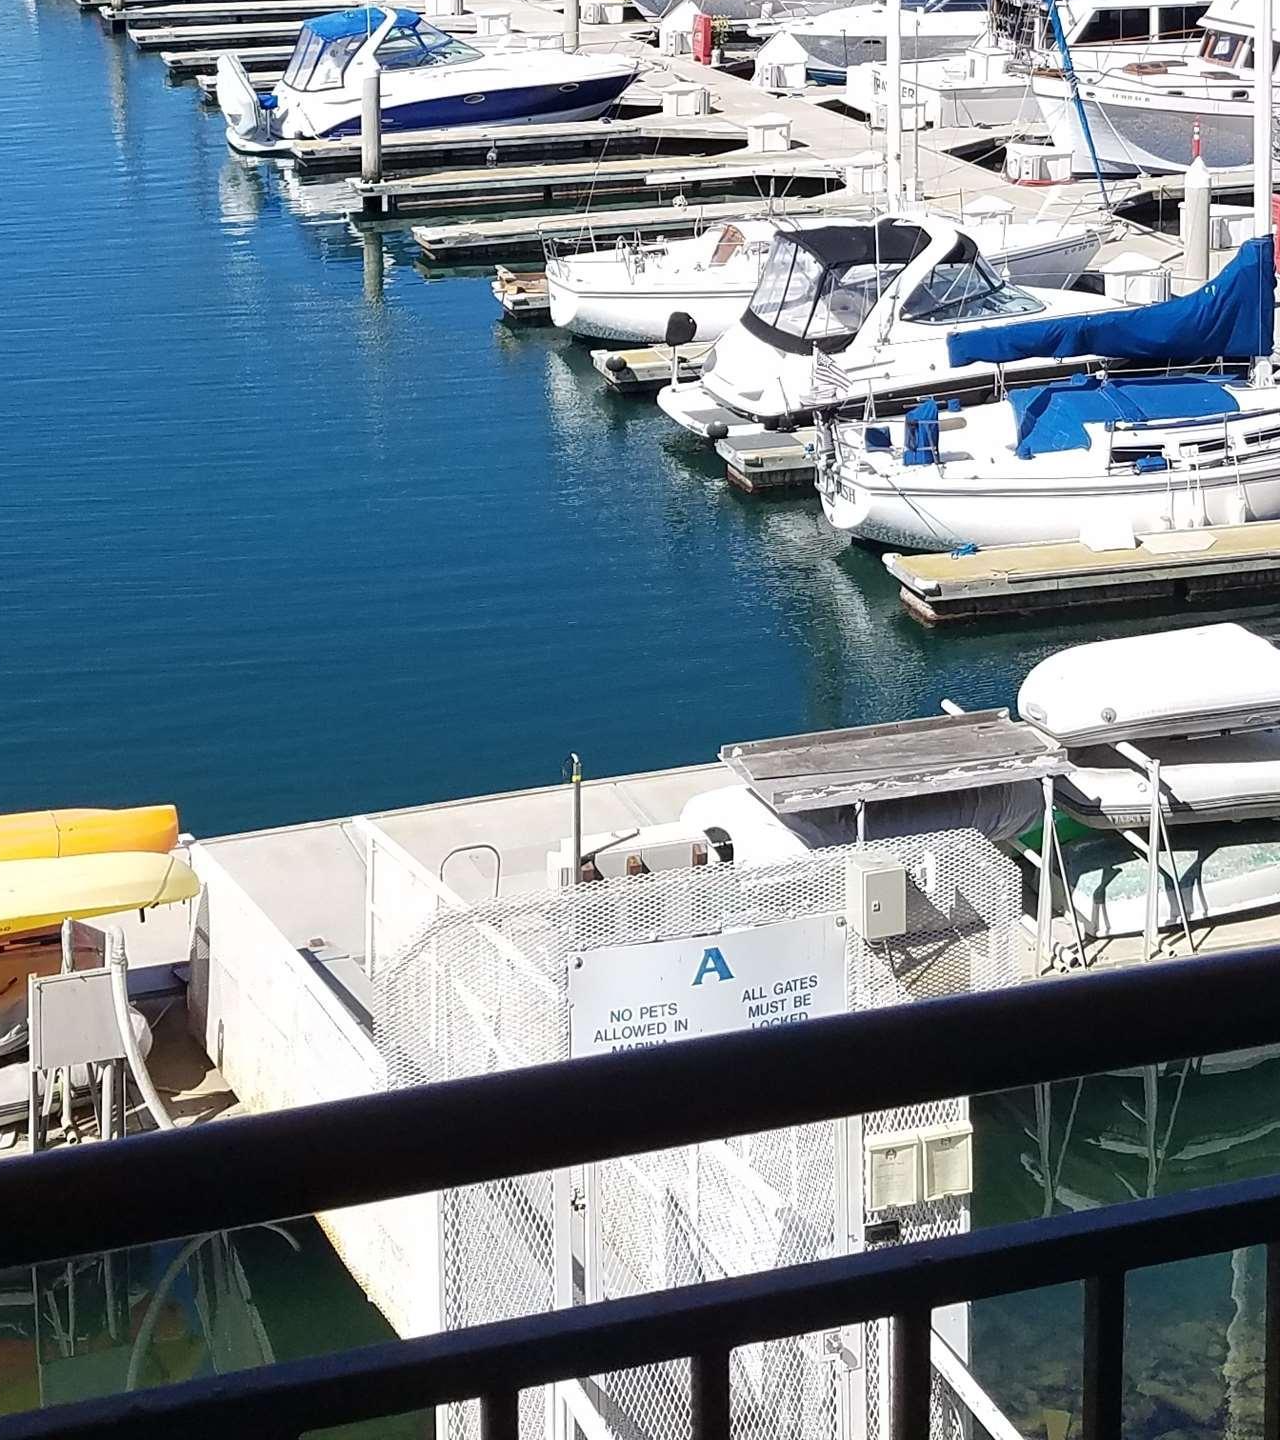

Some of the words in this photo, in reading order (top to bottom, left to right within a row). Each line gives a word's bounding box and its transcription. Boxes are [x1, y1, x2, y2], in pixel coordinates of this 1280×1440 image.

[691, 947, 734, 985] A
[742, 987, 767, 1002] ALL
[773, 975, 818, 996] GATES
[610, 1009, 632, 1023] NO
[639, 1003, 678, 1019] PETS
[748, 999, 787, 1018] MUST
[794, 993, 812, 1008] BE
[593, 1022, 667, 1043] ALLOWED
[674, 1018, 688, 1033] IN
